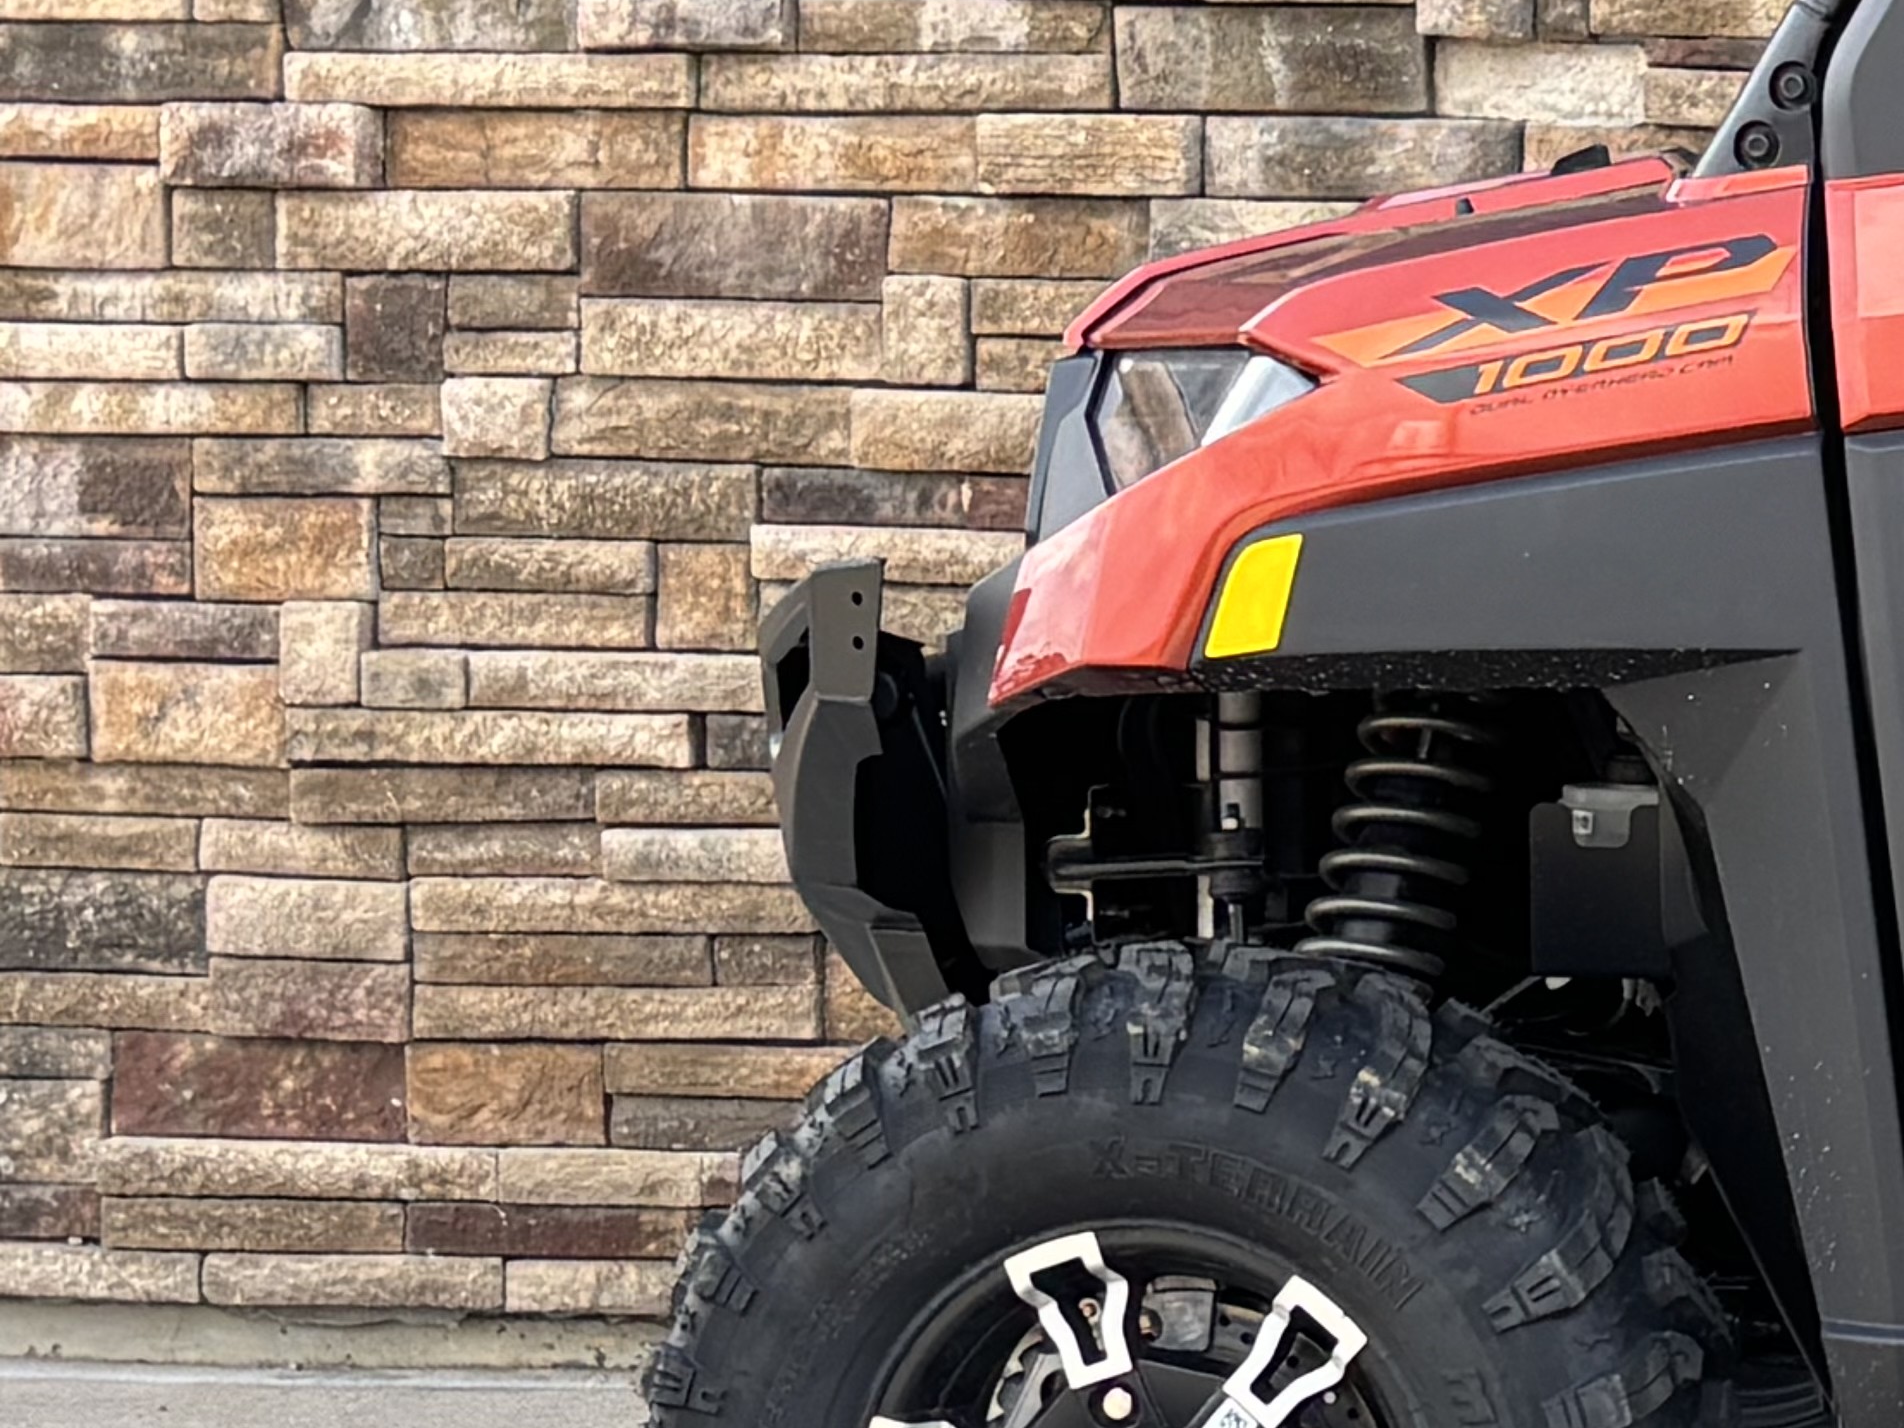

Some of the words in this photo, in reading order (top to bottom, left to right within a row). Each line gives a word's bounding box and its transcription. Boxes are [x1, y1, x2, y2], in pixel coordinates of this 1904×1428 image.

[1380, 234, 1779, 359] XP
[1469, 396, 1534, 415] DUAL
[1542, 368, 1674, 400] OVERHEAD
[1678, 355, 1734, 373] CAM
[1472, 312, 1751, 395] 1000
[1091, 1136, 1425, 1311] X-TERRAIN
